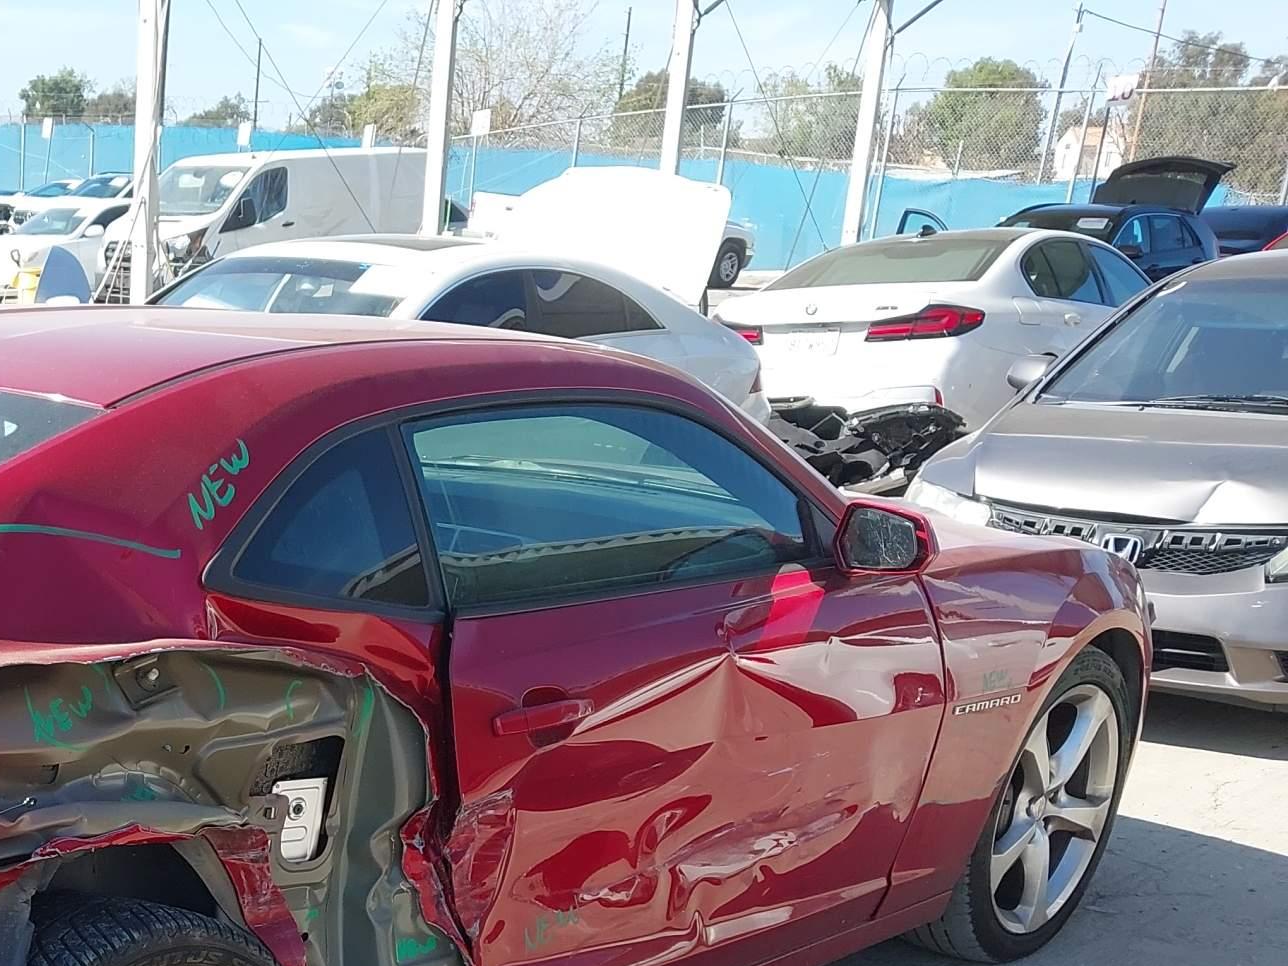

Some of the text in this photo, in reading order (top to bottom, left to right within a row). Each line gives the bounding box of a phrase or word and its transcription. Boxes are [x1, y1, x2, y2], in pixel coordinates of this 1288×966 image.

[187, 438, 250, 530] NEW
[24, 685, 92, 744] NEW
[953, 694, 1021, 716] CAMARO
